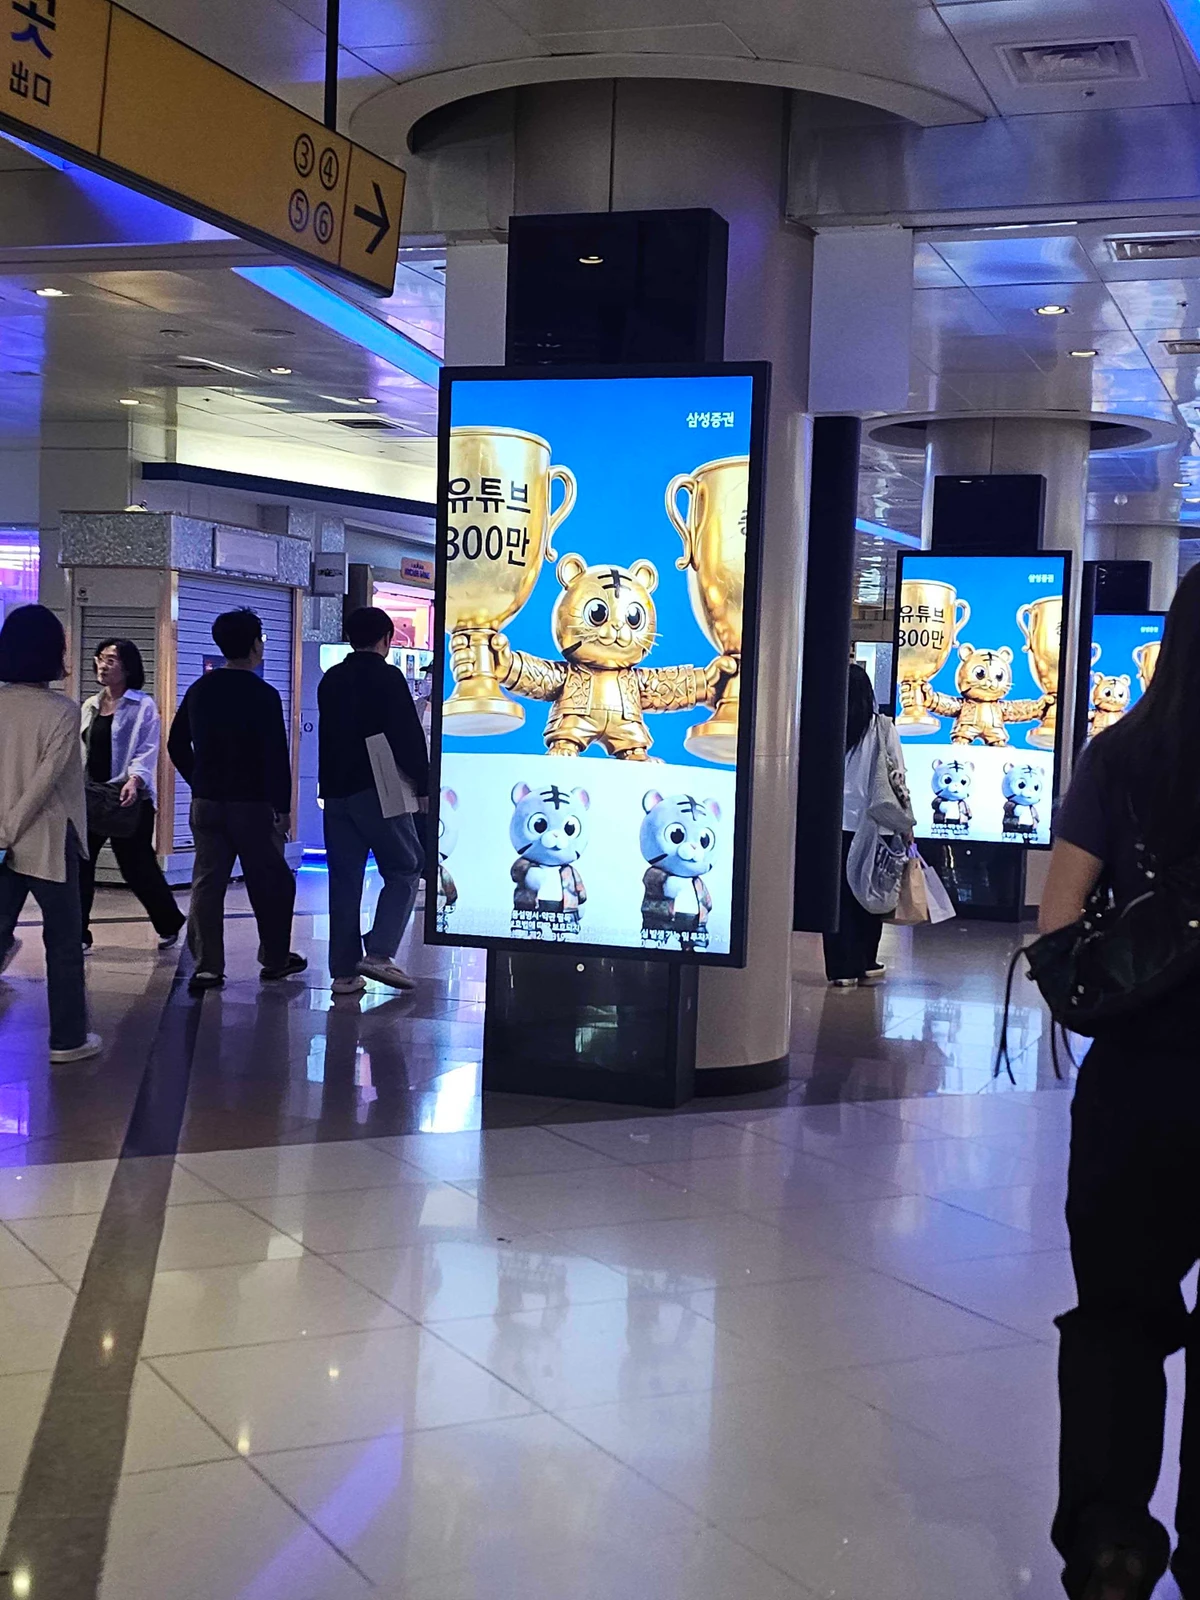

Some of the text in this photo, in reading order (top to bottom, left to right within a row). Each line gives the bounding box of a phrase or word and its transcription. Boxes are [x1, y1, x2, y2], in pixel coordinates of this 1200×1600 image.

[9, 60, 52, 107] 出口
[686, 411, 734, 429] 삼성증권
[447, 477, 531, 514] 유튜브
[899, 605, 946, 624] 유튜브
